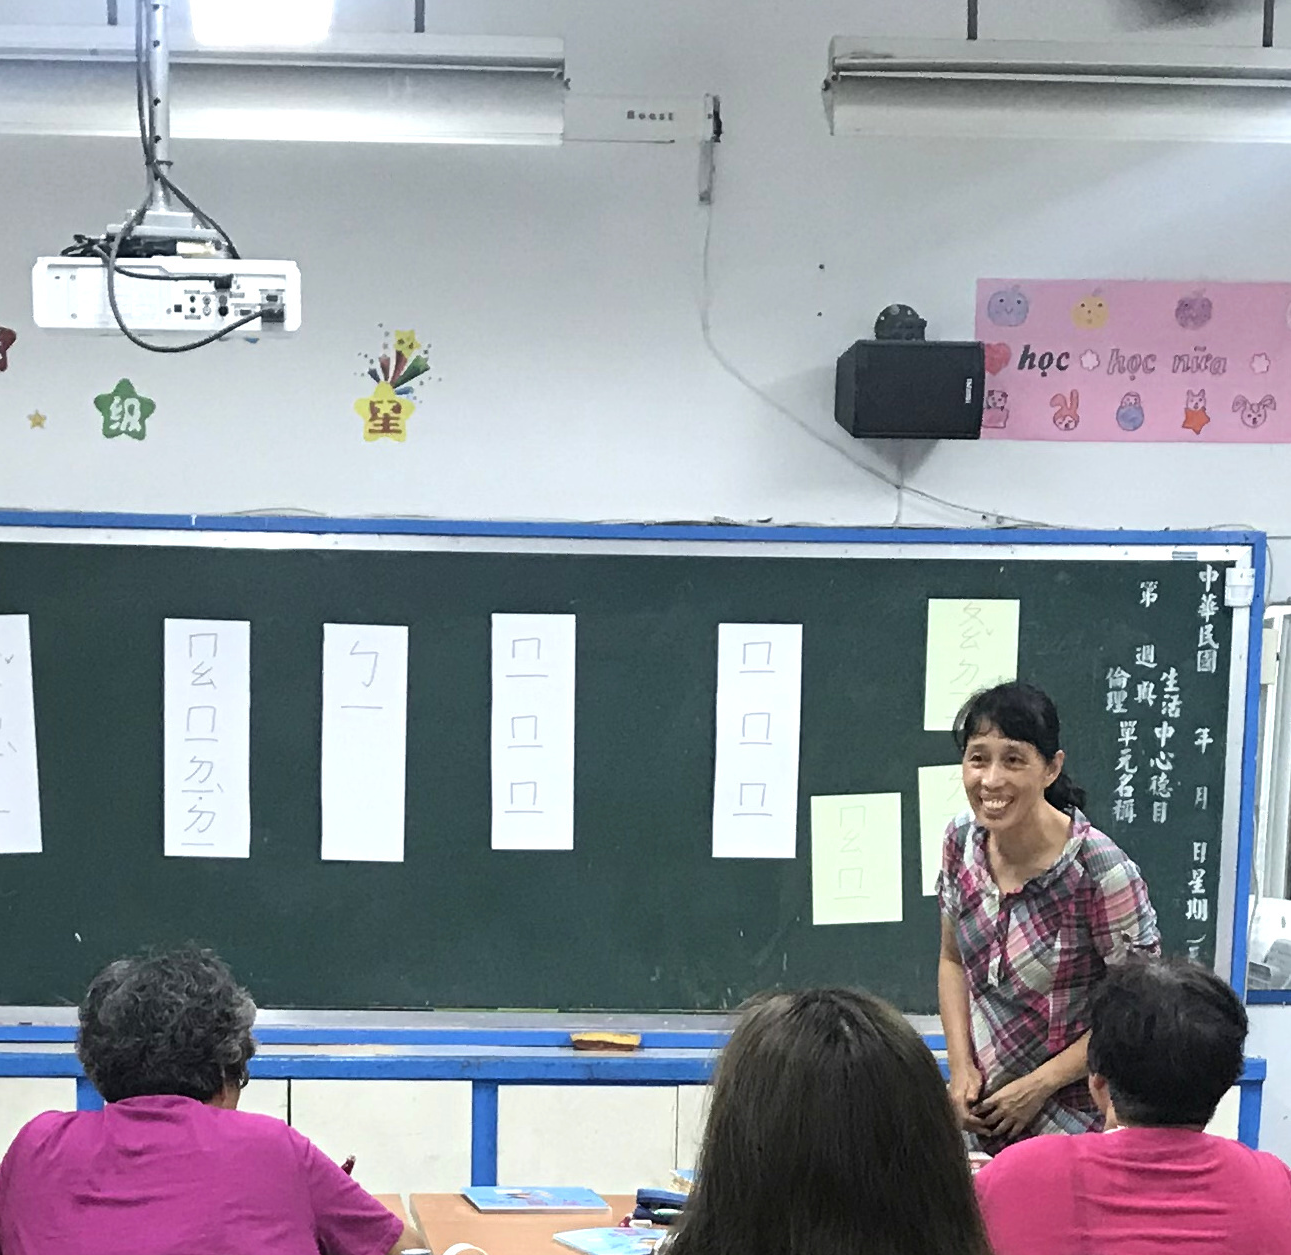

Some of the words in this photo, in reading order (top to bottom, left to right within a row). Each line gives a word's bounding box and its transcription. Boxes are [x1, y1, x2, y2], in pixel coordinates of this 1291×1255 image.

[1017, 343, 1071, 378] học
[1106, 348, 1158, 381] học
[367, 398, 403, 436] 星
[1139, 580, 1159, 608] 第
[1196, 563, 1221, 674] 中華民國
[1105, 666, 1132, 714] 倫理
[1159, 666, 1183, 718] 生活
[1112, 719, 1139, 825] 單元名稱
